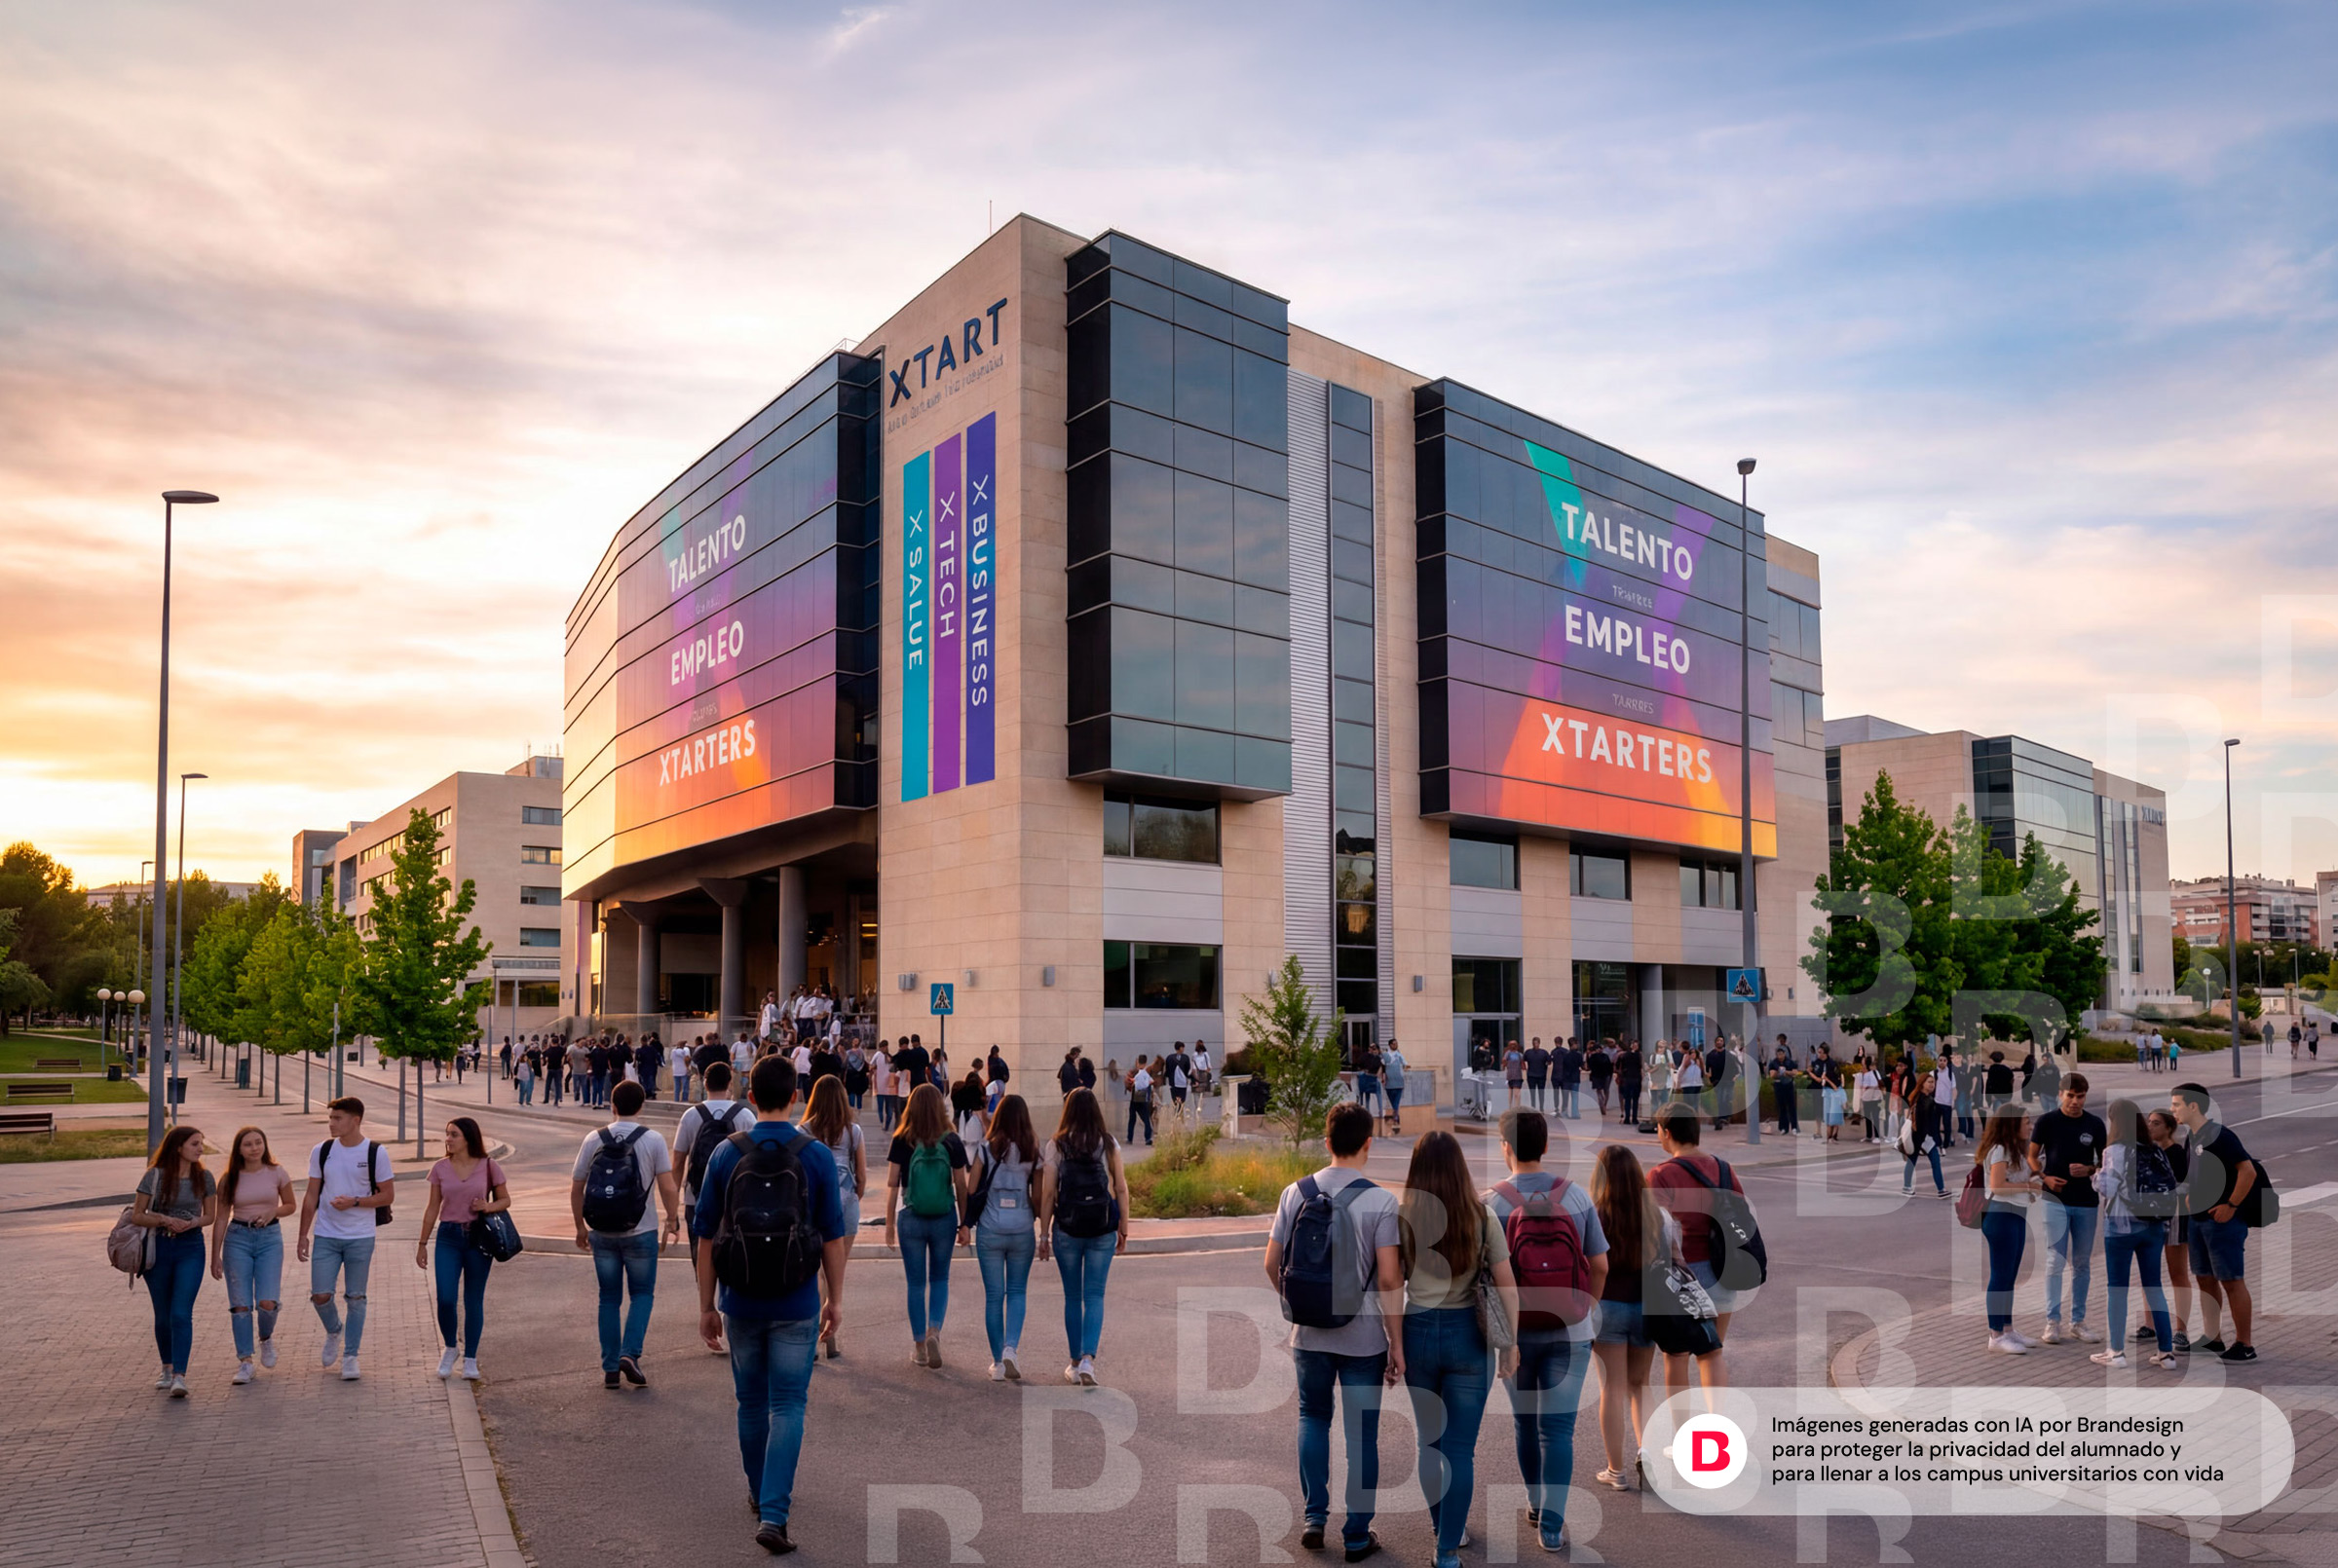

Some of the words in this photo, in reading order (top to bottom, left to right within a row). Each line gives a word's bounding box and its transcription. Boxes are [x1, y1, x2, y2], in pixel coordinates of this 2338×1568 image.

[888, 297, 1008, 409] XTART
[668, 514, 746, 593] TALENTO
[1561, 501, 1693, 580] TALENTO
[908, 545, 924, 671] SALUE
[939, 530, 956, 639] TECH
[971, 512, 988, 708] BUSINESS
[671, 620, 744, 687] EMPLEO
[1565, 604, 1690, 675] EMPLEO
[659, 719, 756, 787] XTARTERS
[1540, 712, 1712, 784] XTARTERS
